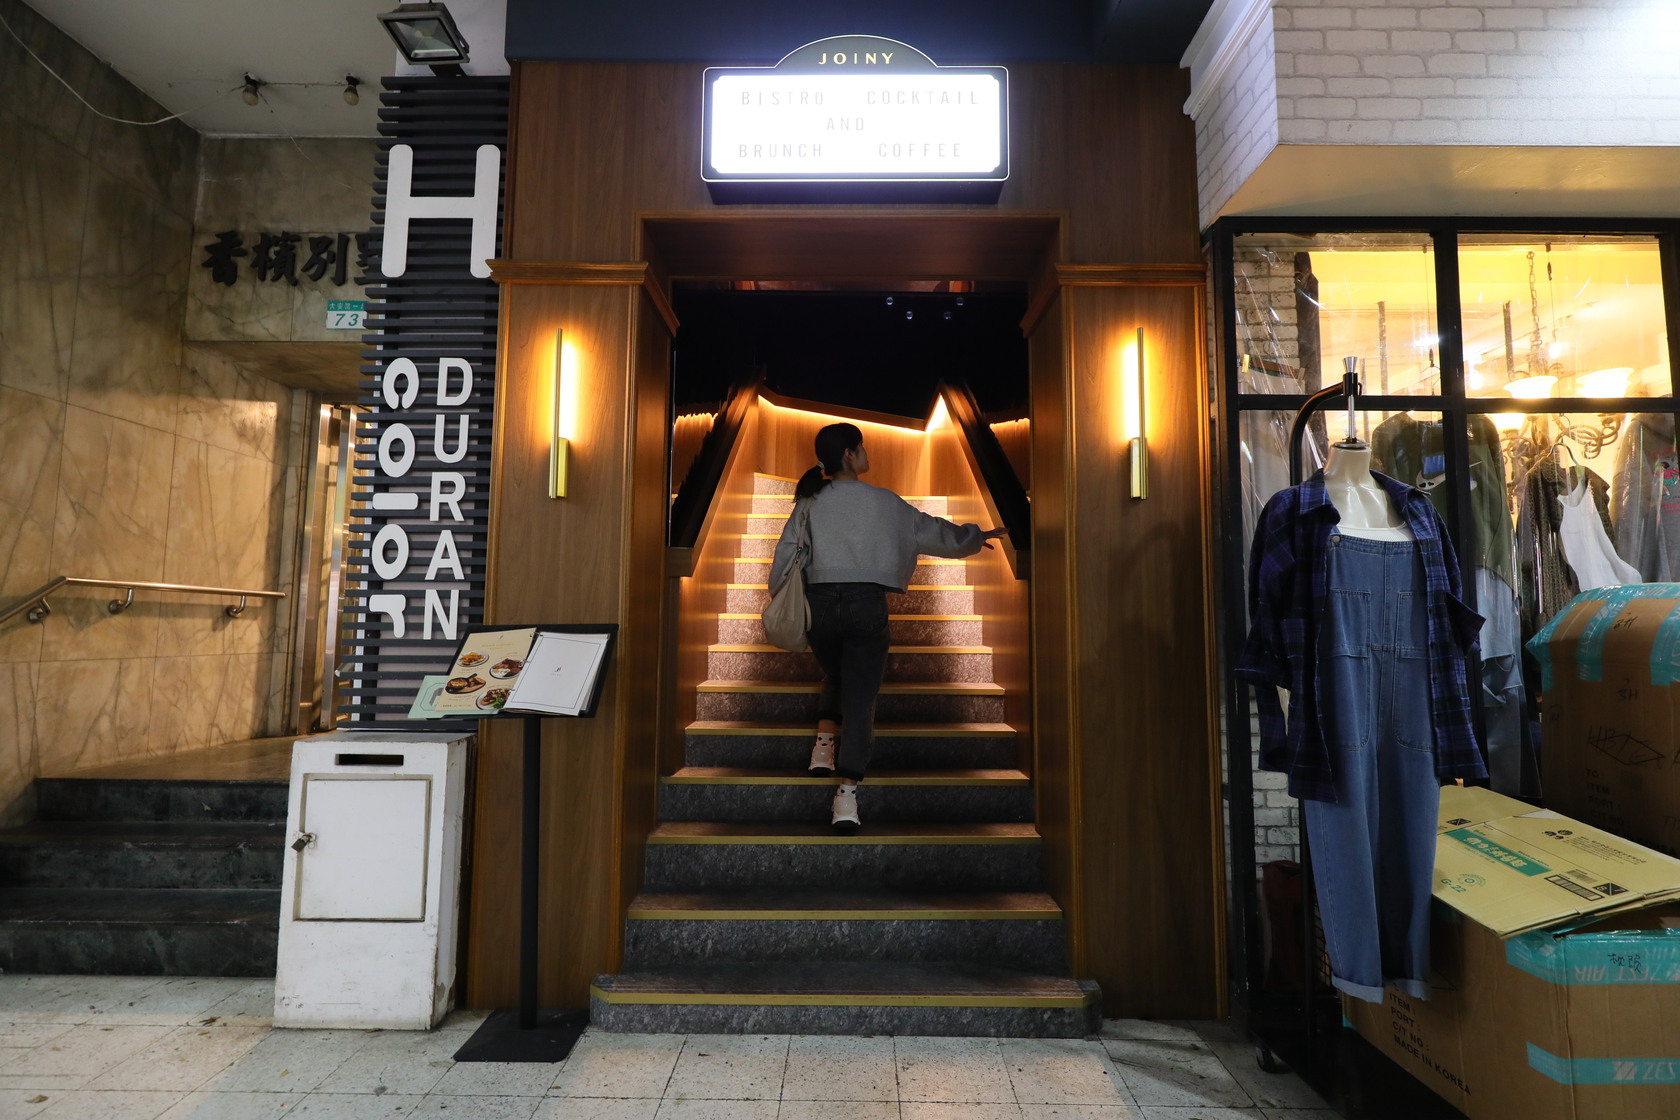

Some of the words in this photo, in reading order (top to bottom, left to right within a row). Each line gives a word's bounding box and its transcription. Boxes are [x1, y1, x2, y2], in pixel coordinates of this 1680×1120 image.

[818, 52, 894, 65] JOINY
[741, 91, 824, 106] BISTRO
[867, 90, 978, 105] COCKTAIL
[826, 117, 865, 132] AND
[739, 143, 822, 158] BRUNCH
[878, 143, 961, 158] COFFEE
[335, 313, 359, 326] 73
[423, 357, 473, 640] DURAN
[1441, 878, 1467, 893] G-22
[1389, 993, 1411, 1012] ITEM
[1390, 1006, 1415, 1028] PORT
[1393, 1035, 1420, 1058] MADE
[1422, 1055, 1432, 1067] IN
[1435, 1063, 1471, 1096] KOREA
[1642, 1062, 1680, 1080] ZES
